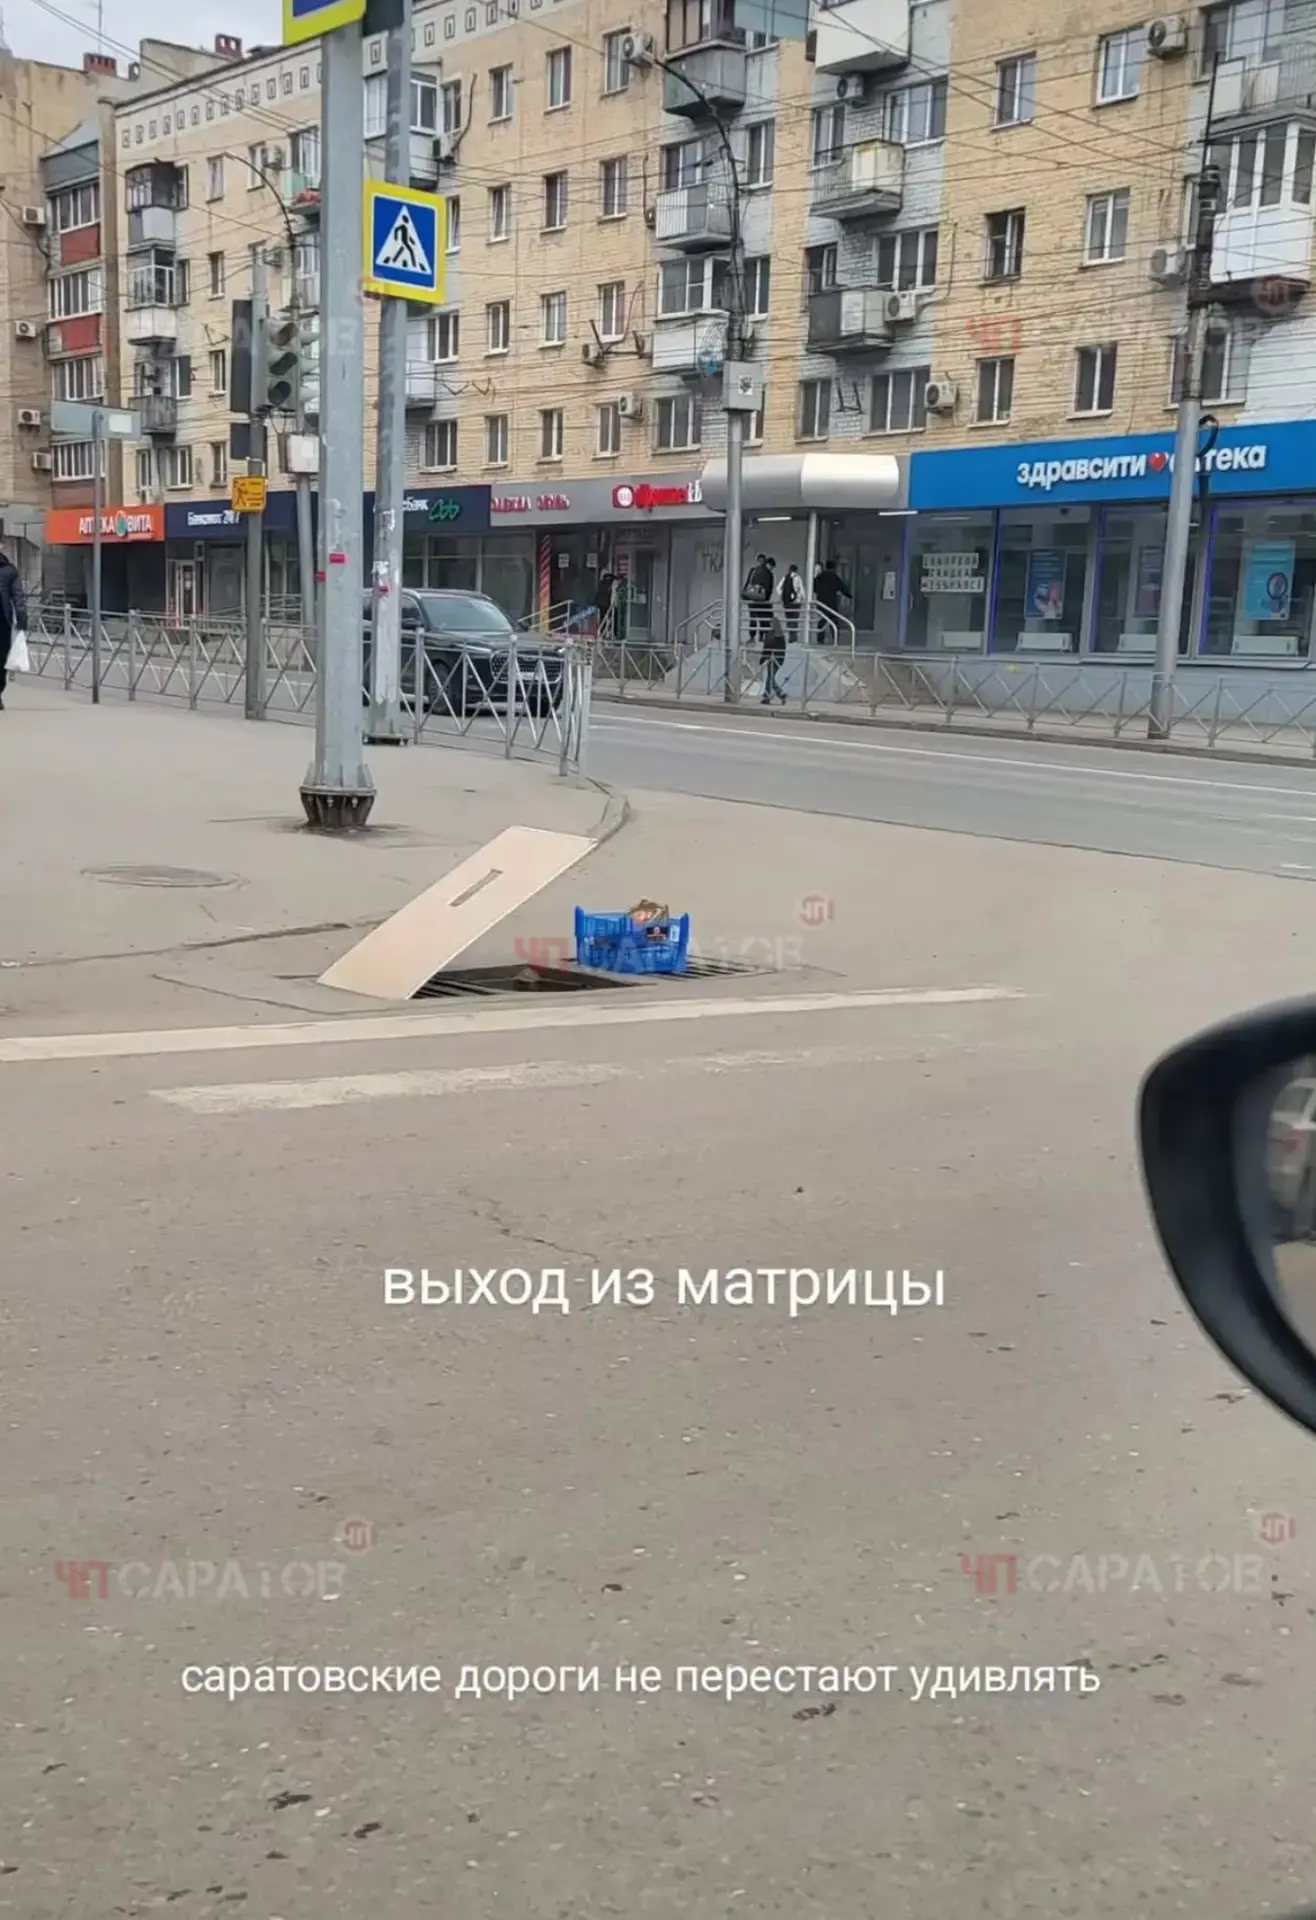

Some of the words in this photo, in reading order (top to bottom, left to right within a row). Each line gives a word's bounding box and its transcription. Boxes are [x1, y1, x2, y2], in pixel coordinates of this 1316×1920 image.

[1016, 455, 1146, 491] здравсити
[1169, 445, 1267, 474] тека
[79, 515, 115, 534] АПКА
[127, 514, 152, 533] ВИТА
